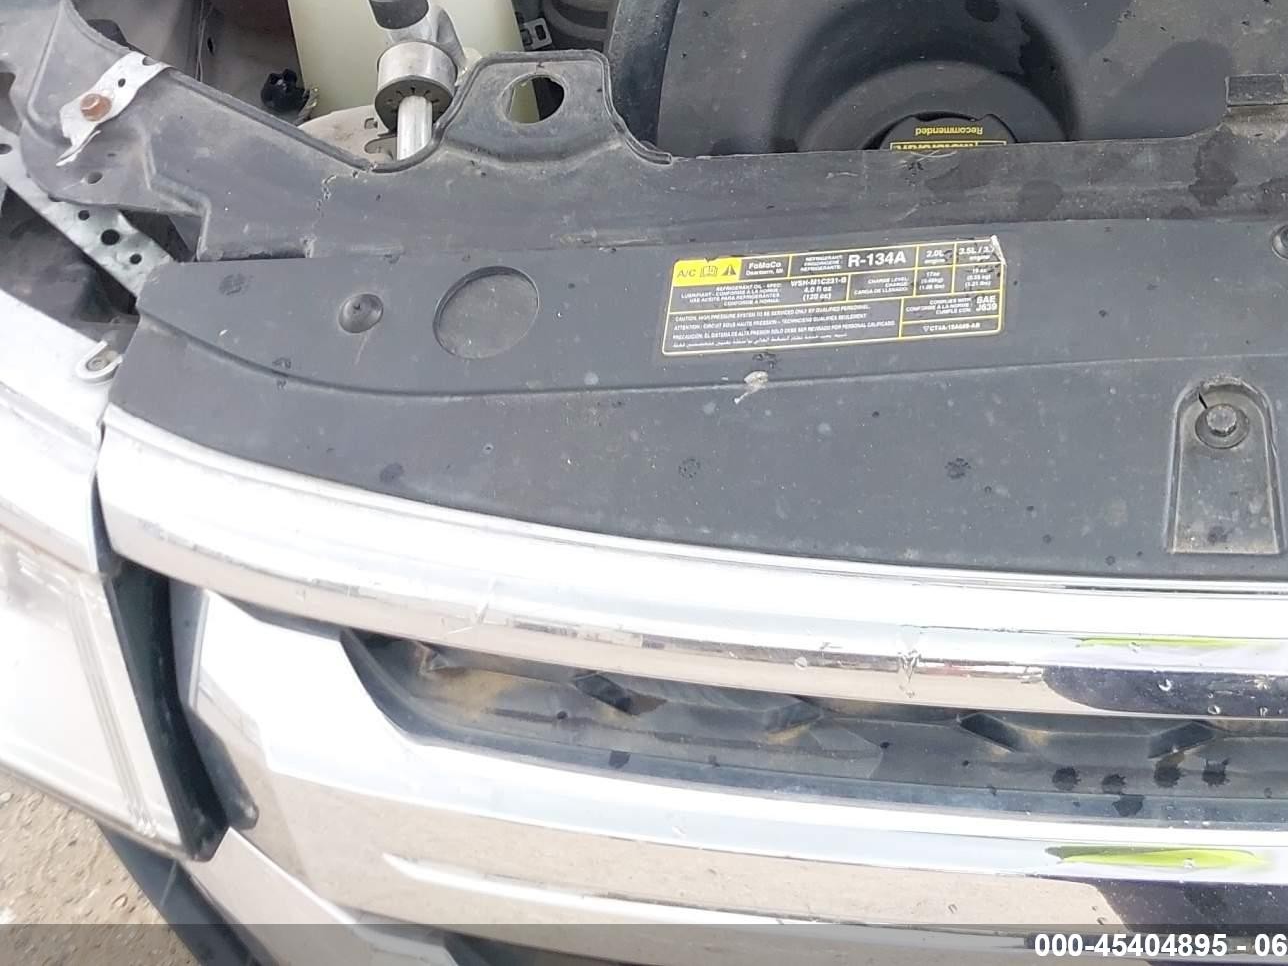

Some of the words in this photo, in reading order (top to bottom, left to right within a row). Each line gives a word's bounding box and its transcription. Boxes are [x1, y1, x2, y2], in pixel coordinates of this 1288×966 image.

[914, 125, 984, 136] Recommended
[848, 251, 906, 268] R-134A
[749, 261, 781, 270] FoMoCo
[677, 269, 696, 278] A/C
[977, 295, 996, 304] SAE
[976, 303, 997, 312] J639
